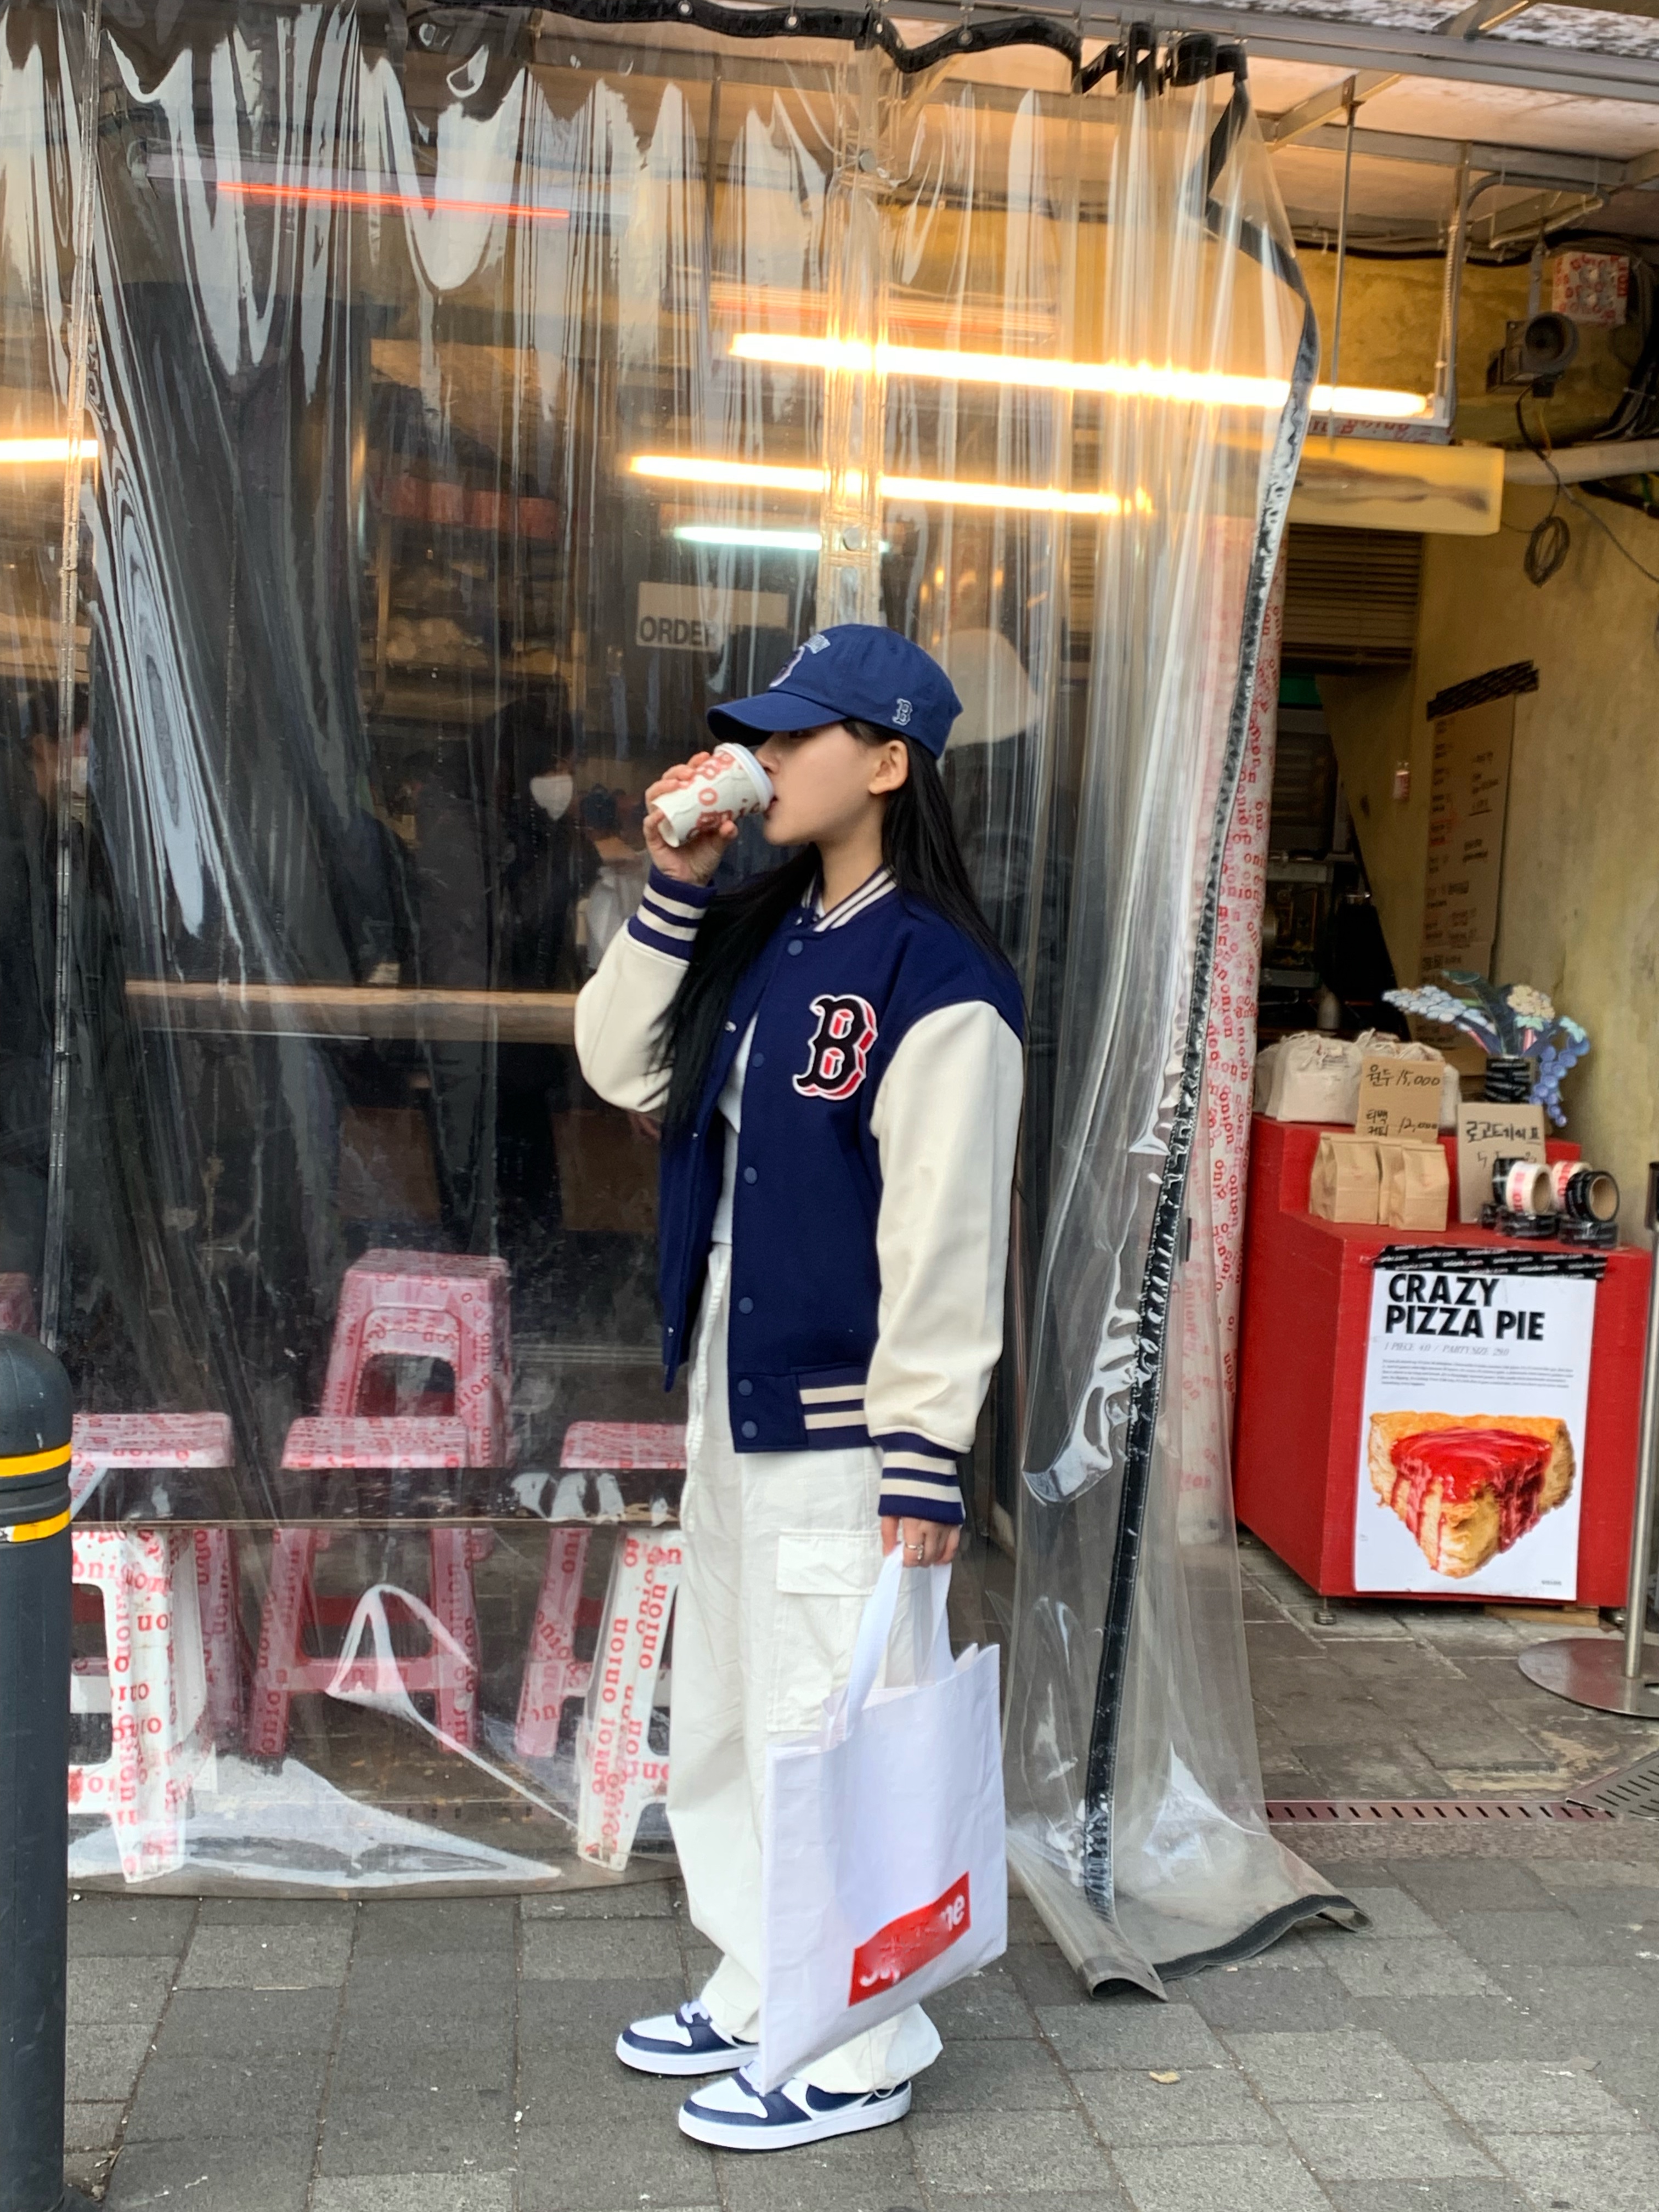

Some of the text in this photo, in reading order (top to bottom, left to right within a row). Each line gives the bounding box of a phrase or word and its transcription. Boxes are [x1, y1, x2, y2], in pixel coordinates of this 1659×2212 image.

[892, 698, 913, 726] B
[1221, 983, 1233, 1038] onion
[793, 994, 878, 1100] B
[1366, 1064, 1440, 1087] 원두 15,000
[1220, 1092, 1234, 1145] onion
[1398, 1117, 1437, 1134] 12,000
[1389, 1274, 1500, 1307] CRAZY
[1385, 1305, 1545, 1340] PIZZA PIE
[638, 1584, 668, 1670] onion
[602, 1616, 629, 1702] onion
